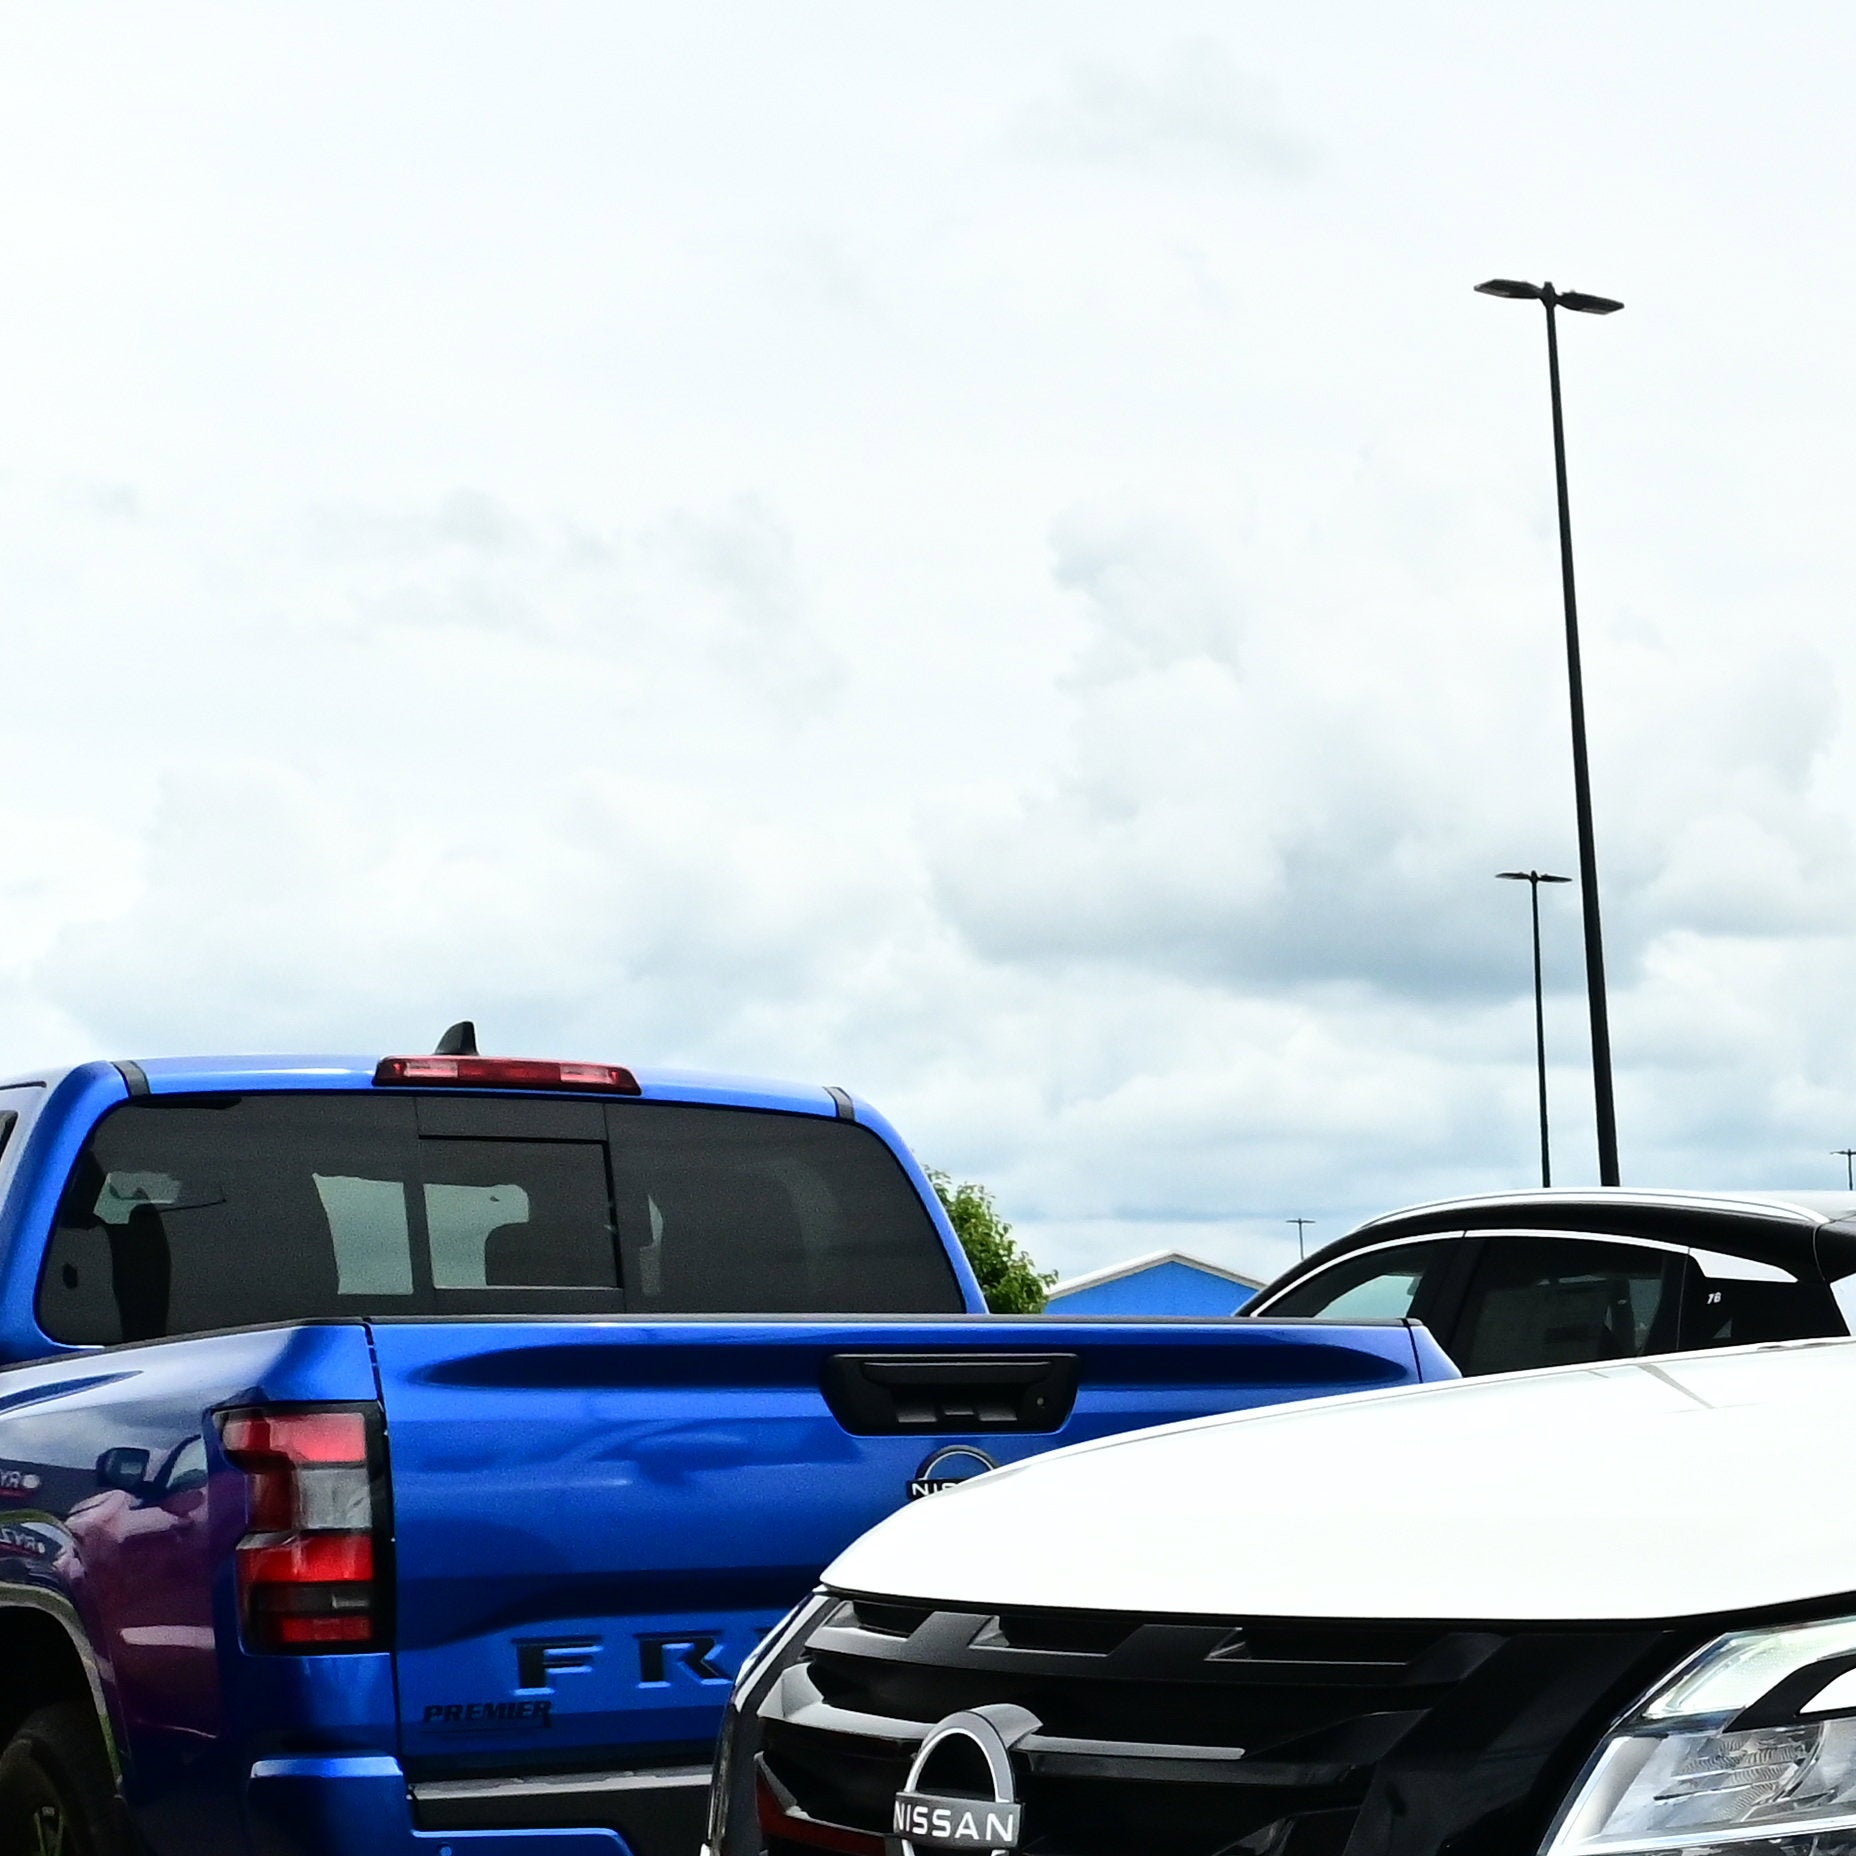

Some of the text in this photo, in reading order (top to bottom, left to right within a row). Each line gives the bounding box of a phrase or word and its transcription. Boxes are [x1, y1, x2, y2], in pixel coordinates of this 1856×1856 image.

[510, 1627, 770, 1696] FR
[423, 1700, 552, 1728] PREMIER
[893, 1800, 1014, 1842] NISSAN
